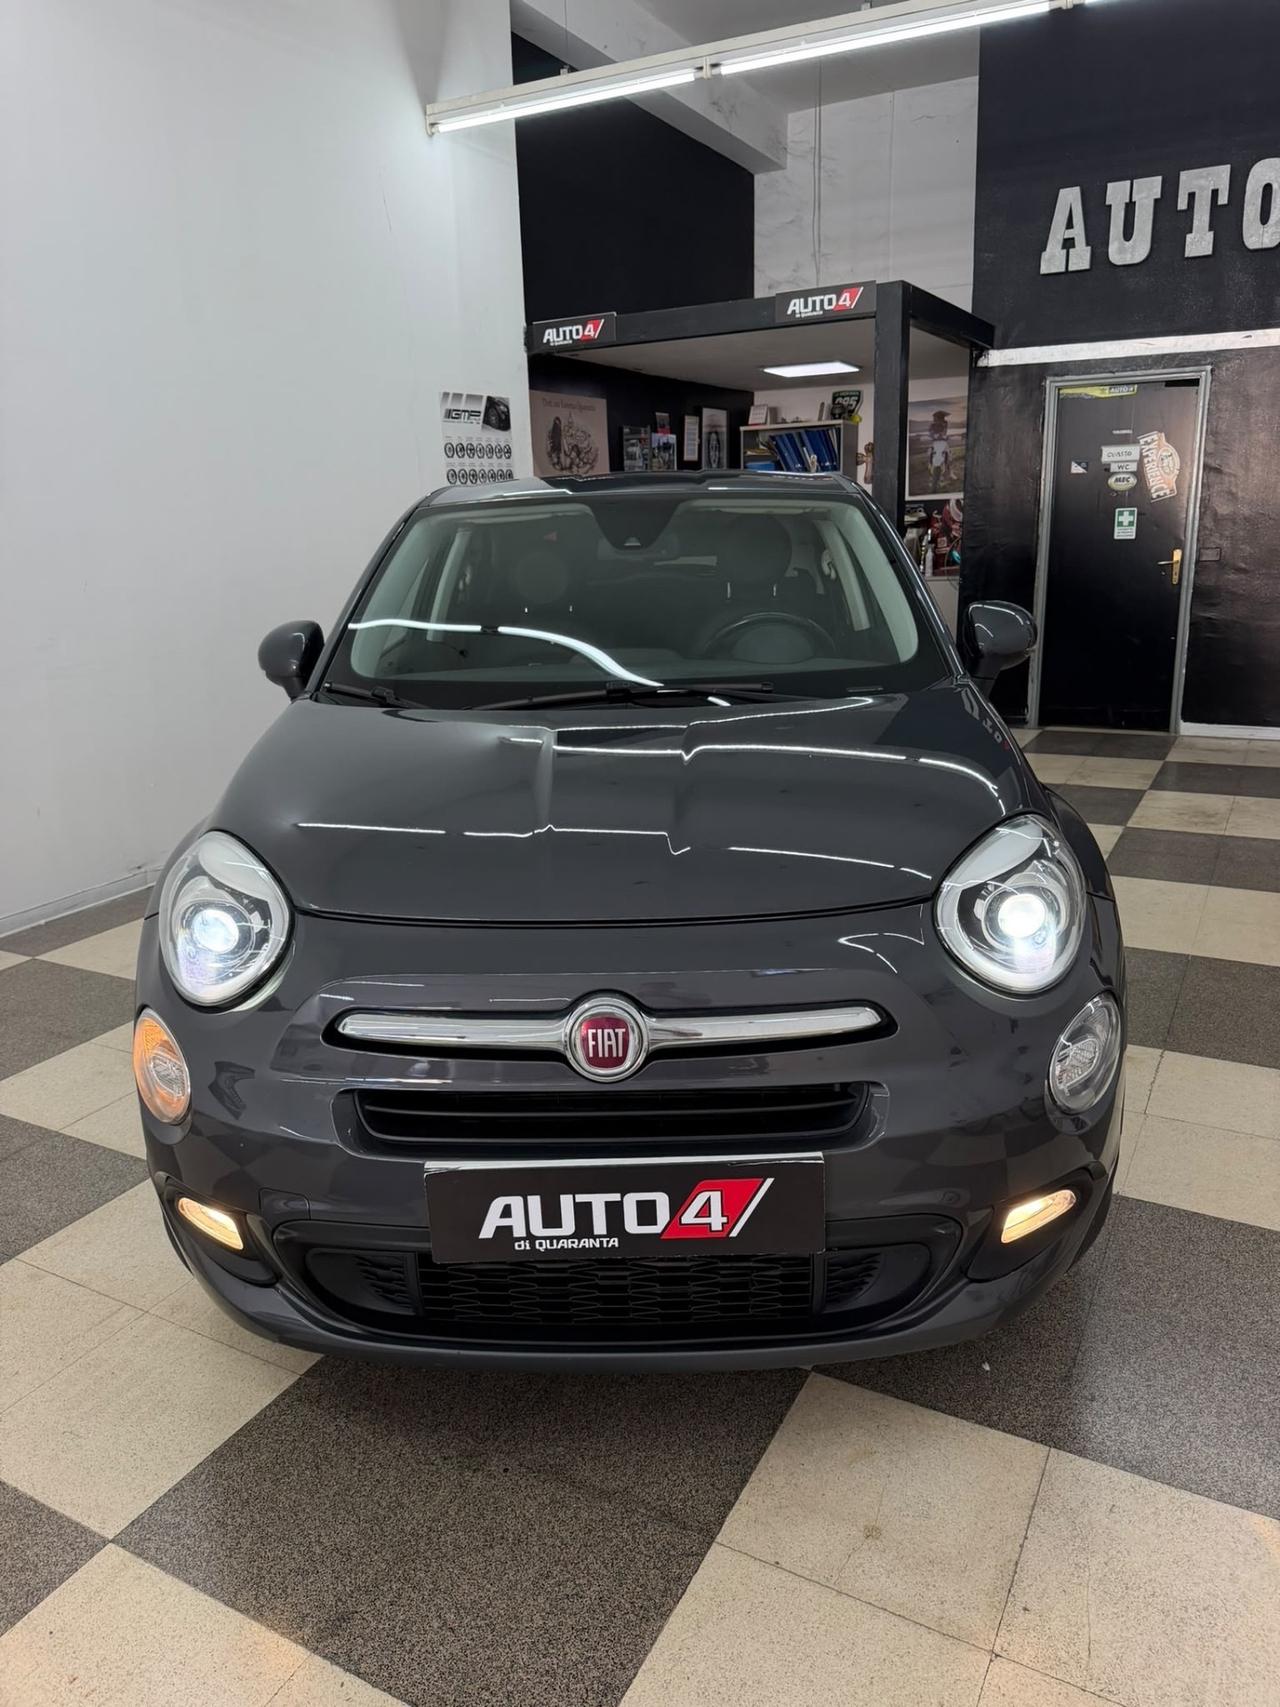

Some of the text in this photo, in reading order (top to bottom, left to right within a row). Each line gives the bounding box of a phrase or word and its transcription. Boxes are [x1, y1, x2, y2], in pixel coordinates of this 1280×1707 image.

[1040, 157, 1280, 275] AUTO
[588, 1028, 626, 1058] FIAT
[514, 1237, 619, 1252] di QUARANTA
